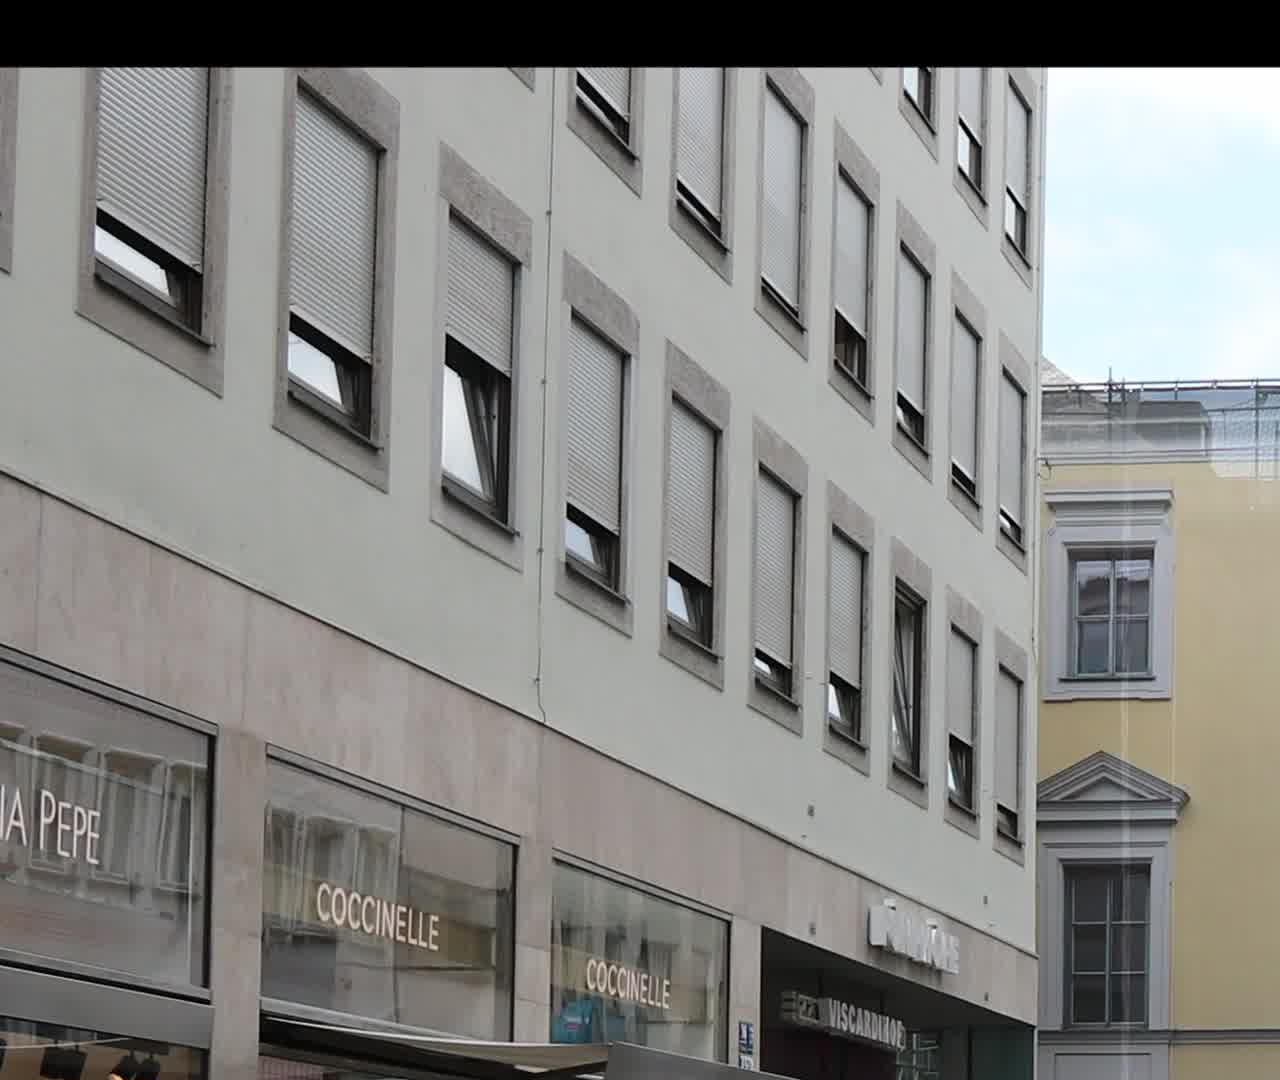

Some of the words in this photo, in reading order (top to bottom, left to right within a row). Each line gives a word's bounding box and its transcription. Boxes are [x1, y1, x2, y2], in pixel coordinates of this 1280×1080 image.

[39, 788, 101, 866] PEPE
[316, 881, 440, 951] COCCINELLE
[586, 957, 671, 1010] COCCINELLE
